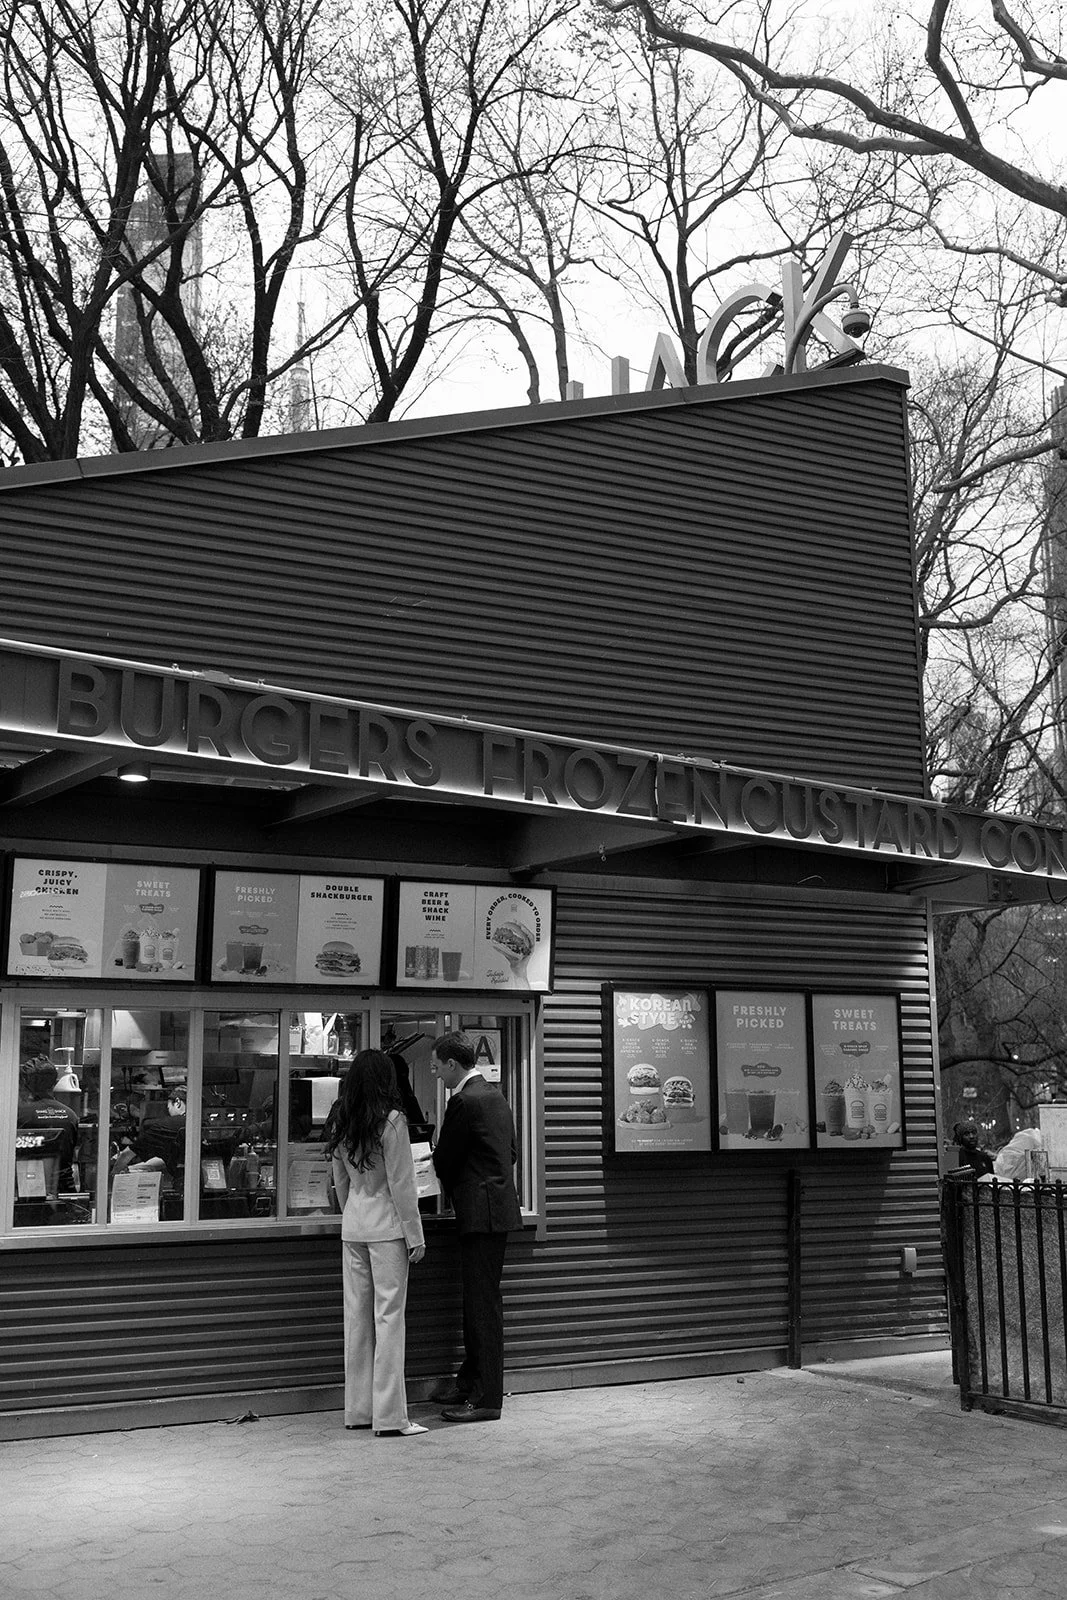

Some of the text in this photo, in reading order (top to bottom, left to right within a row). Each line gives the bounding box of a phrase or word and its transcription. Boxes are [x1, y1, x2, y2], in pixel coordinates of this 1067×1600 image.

[57, 658, 442, 787] BURGERS
[483, 731, 729, 830] FROZEN
[741, 777, 963, 860] CUSTARD
[38, 869, 78, 879] CRISPY,
[43, 878, 72, 886] JUICY
[137, 880, 170, 889] SWEET
[35, 886, 79, 895] CHICKEN
[135, 888, 171, 898] TREATS
[235, 886, 276, 895] FRESHLY
[325, 884, 359, 893] DOUBLE
[237, 895, 273, 903] PICKED
[310, 891, 373, 901] SHACKBURGER
[508, 892, 534, 907] COOKED
[532, 906, 540, 917] TO
[422, 906, 449, 914] SHACK
[732, 1005, 787, 1017] FRESHLY
[834, 1008, 875, 1019] SWEET
[627, 1011, 677, 1026] STYLE
[736, 1018, 785, 1029] PICKED
[832, 1020, 877, 1031] TREATS
[474, 1035, 495, 1066] A
